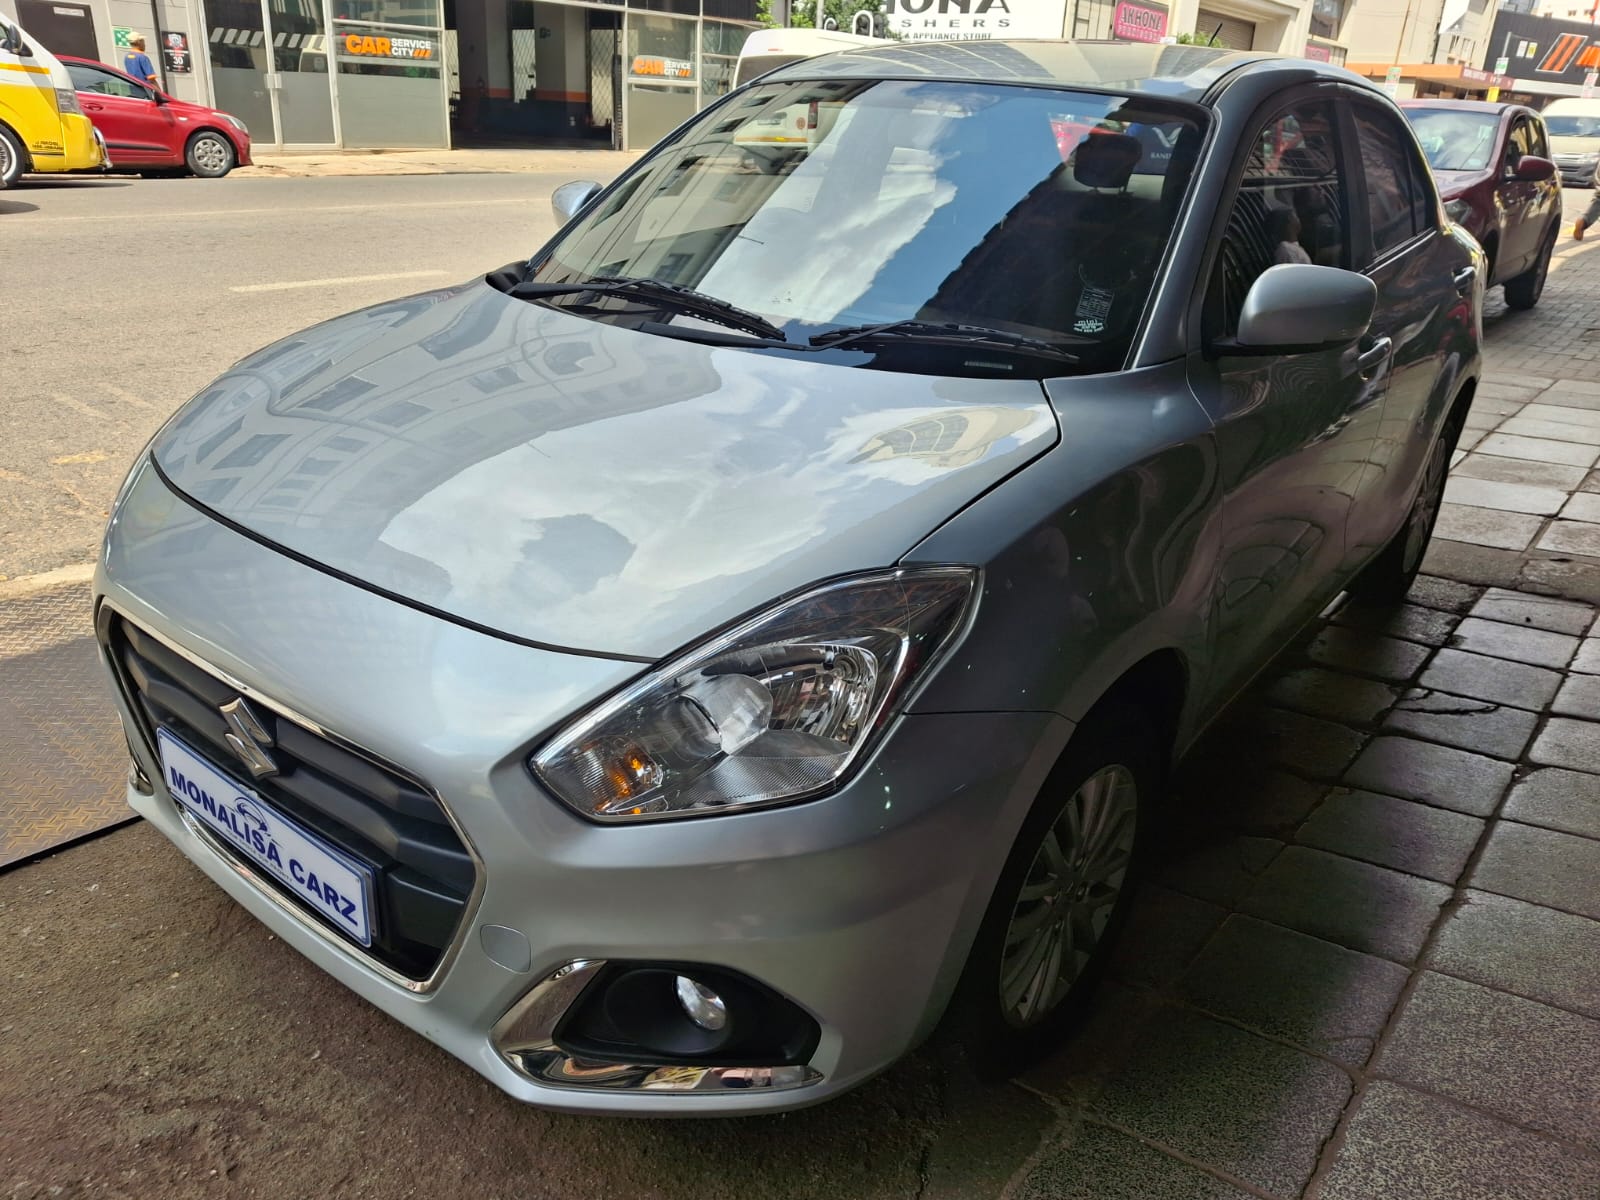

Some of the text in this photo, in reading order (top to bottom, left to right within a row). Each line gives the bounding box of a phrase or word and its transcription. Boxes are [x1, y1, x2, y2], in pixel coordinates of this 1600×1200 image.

[1119, 7, 1162, 30] AKHONA
[913, 32, 960, 40] APPLIANCE
[345, 34, 391, 55] CAR
[391, 38, 432, 49] SERVICE
[391, 47, 414, 56] CITY
[173, 56, 184, 65] 30
[633, 58, 664, 74] CAR
[664, 61, 691, 70] SERVICE
[170, 766, 282, 868] MONALISA
[288, 858, 359, 926] CARZ
